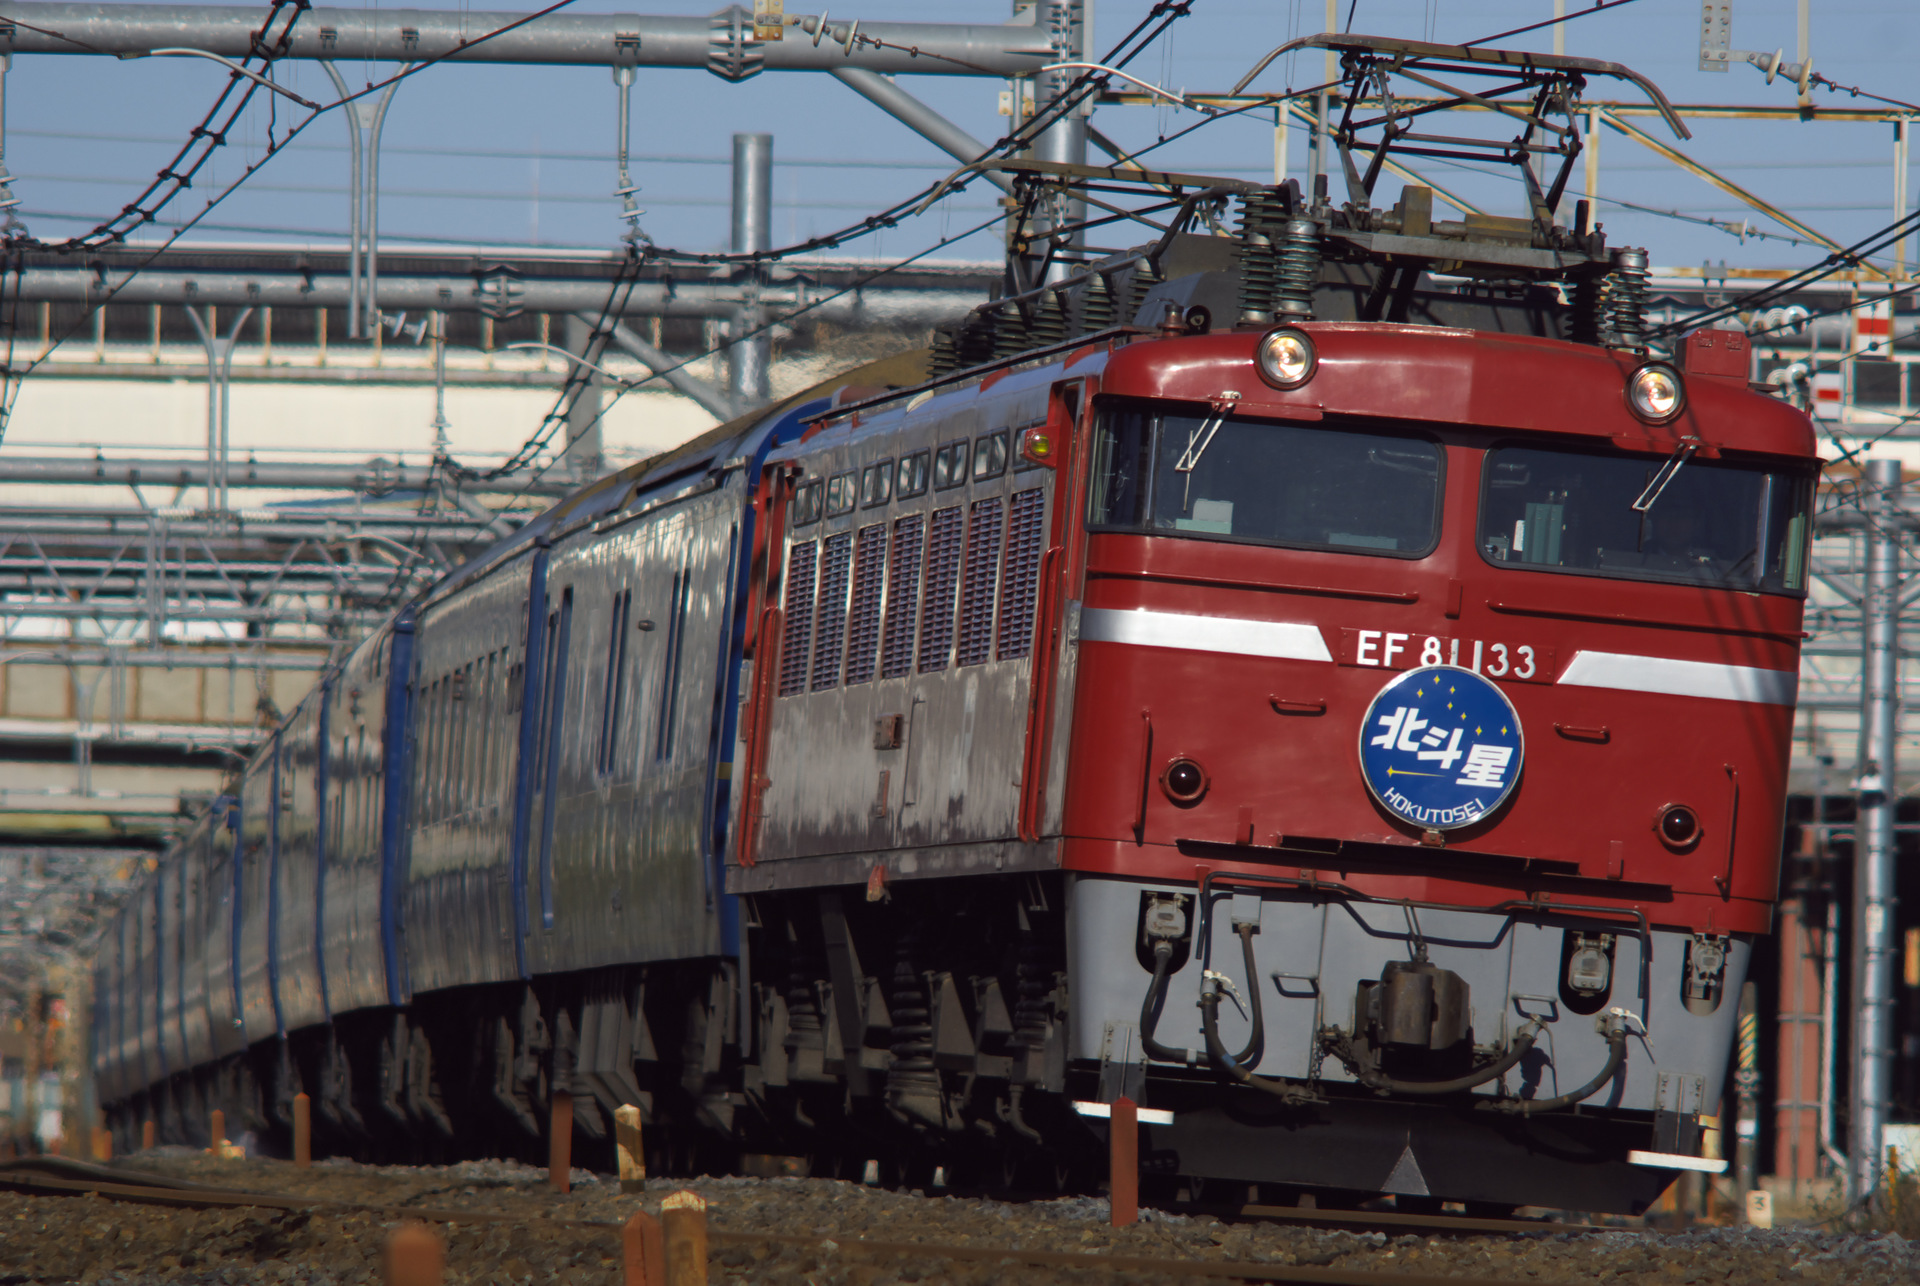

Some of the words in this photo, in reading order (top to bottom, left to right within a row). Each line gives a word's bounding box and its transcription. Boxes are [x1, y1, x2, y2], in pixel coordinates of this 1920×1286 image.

[1357, 630, 1408, 667] EF
[1370, 706, 1513, 788] 北斗星
[1384, 787, 1485, 823] HOKUTOSEI
